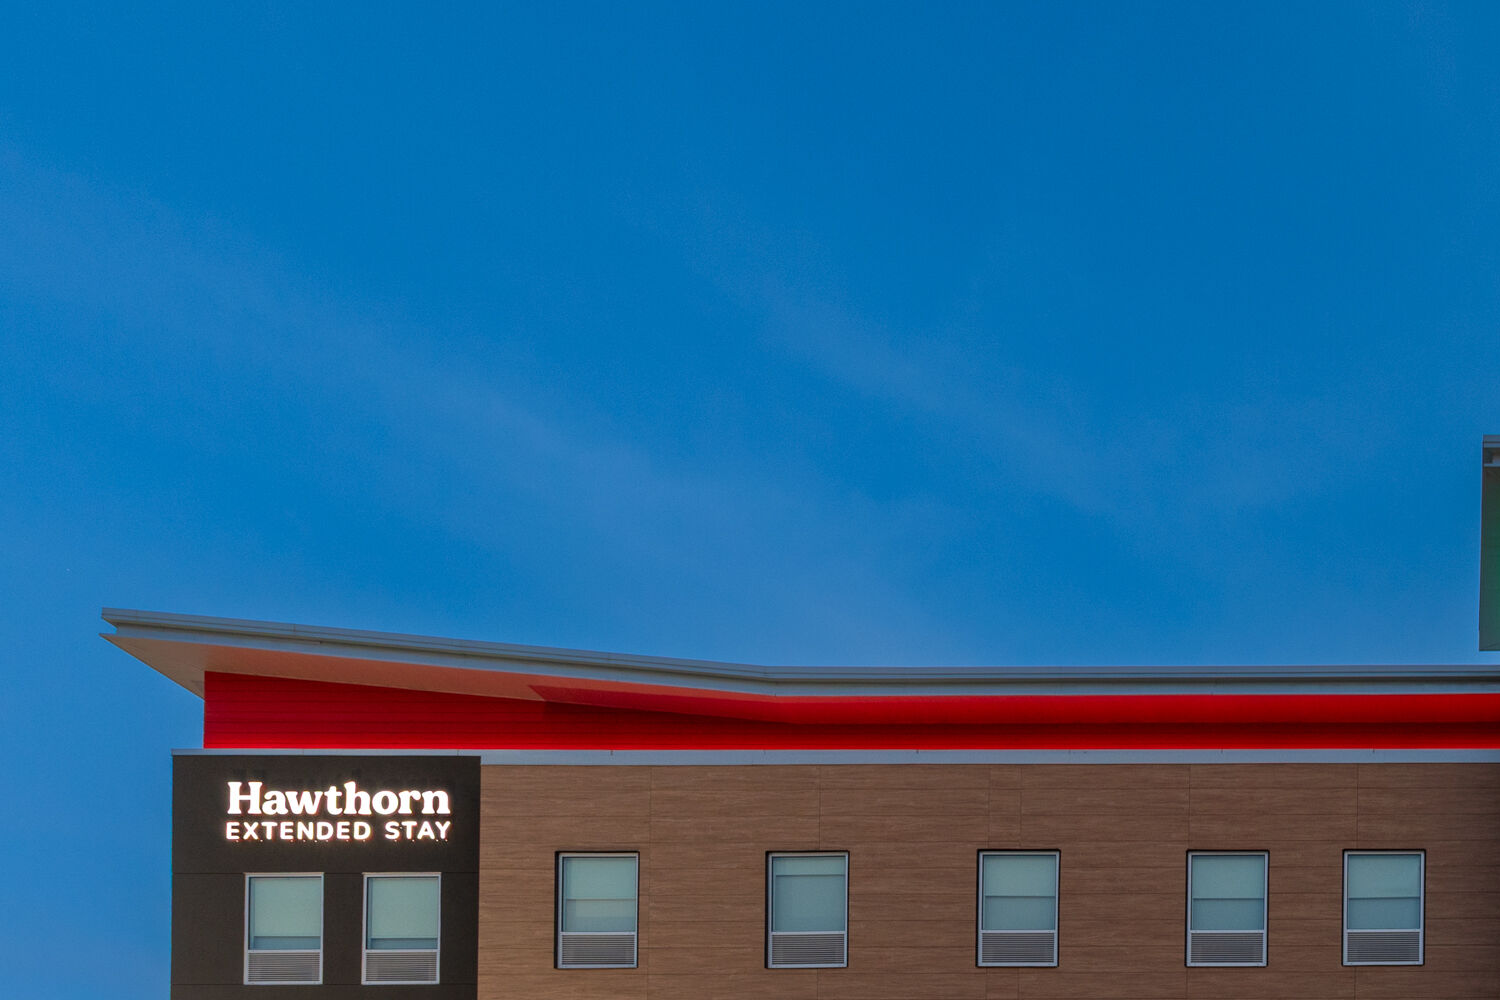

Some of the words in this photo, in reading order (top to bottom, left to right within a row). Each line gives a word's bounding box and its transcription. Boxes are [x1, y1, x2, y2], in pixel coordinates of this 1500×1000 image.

[226, 781, 451, 816] Hawthorn
[226, 821, 371, 841] EXTENDED
[384, 820, 451, 841] STAY
